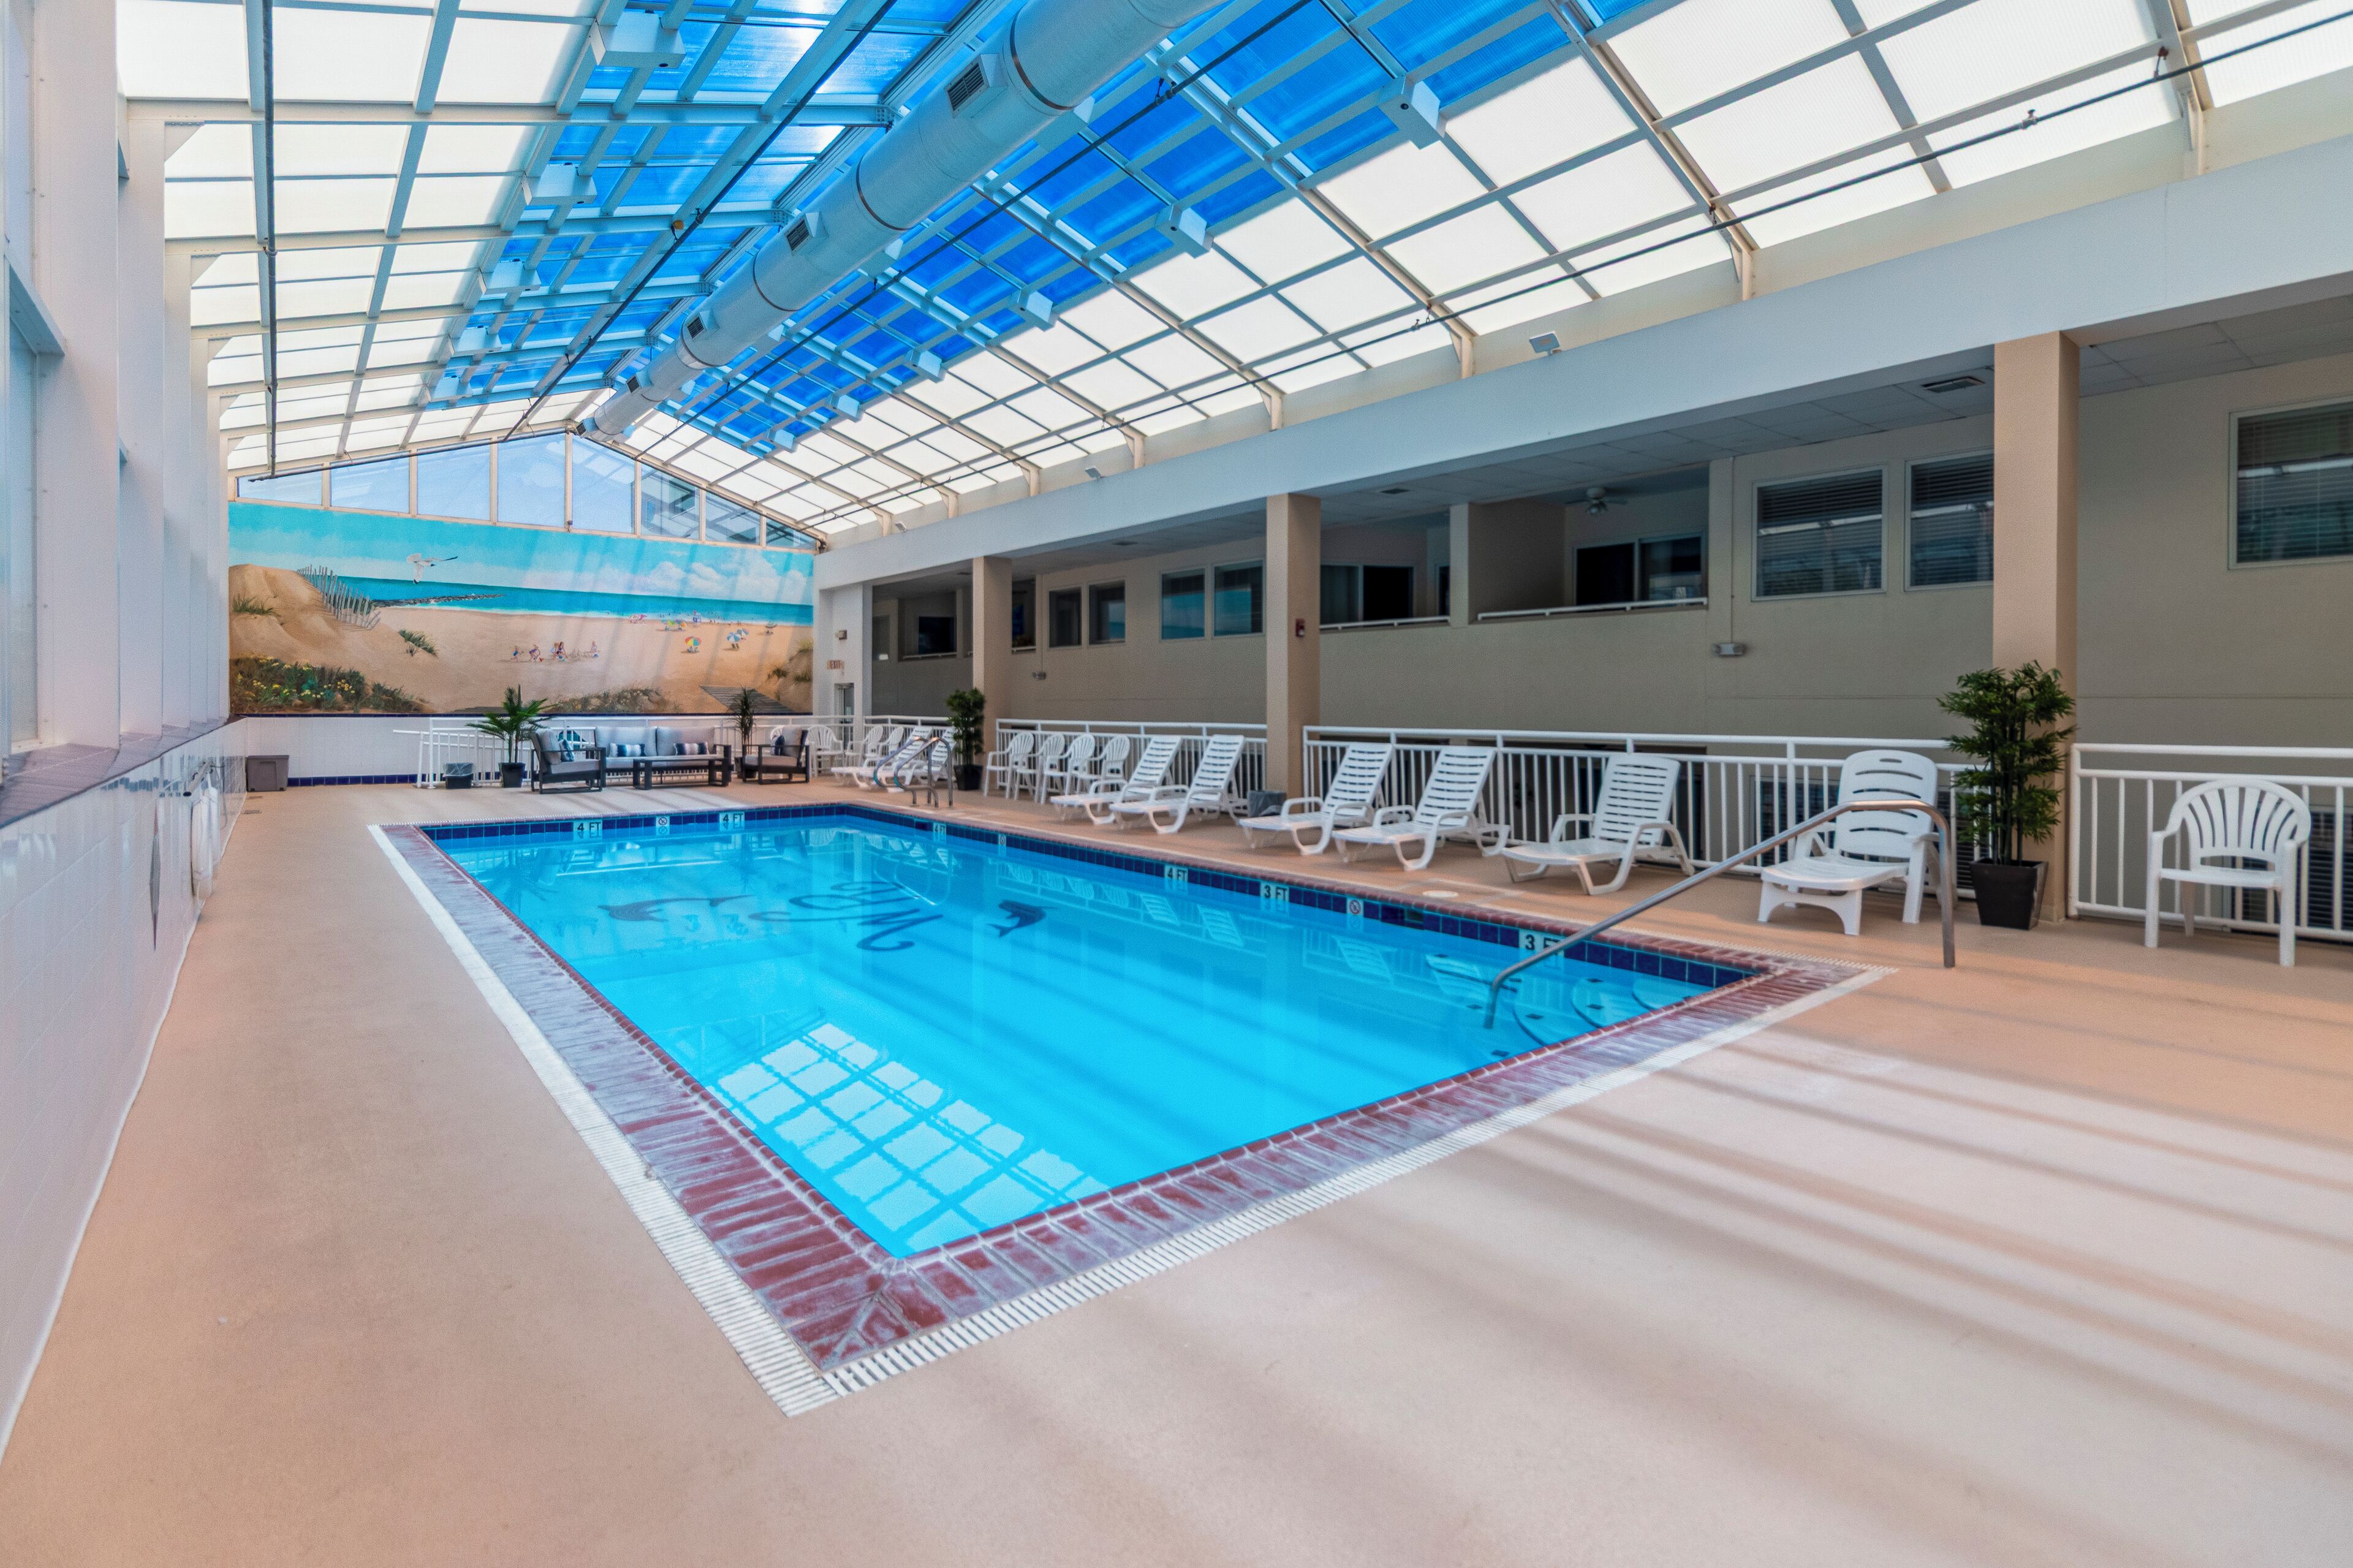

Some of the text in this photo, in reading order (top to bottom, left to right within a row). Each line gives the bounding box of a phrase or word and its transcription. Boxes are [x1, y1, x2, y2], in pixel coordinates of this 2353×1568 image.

[723, 813, 743, 822] 4 FT
[577, 822, 601, 831] 4 FT
[1167, 867, 1187, 882] 4 FT
[1264, 885, 1287, 901] 3 FT
[1525, 934, 1535, 950] 3
